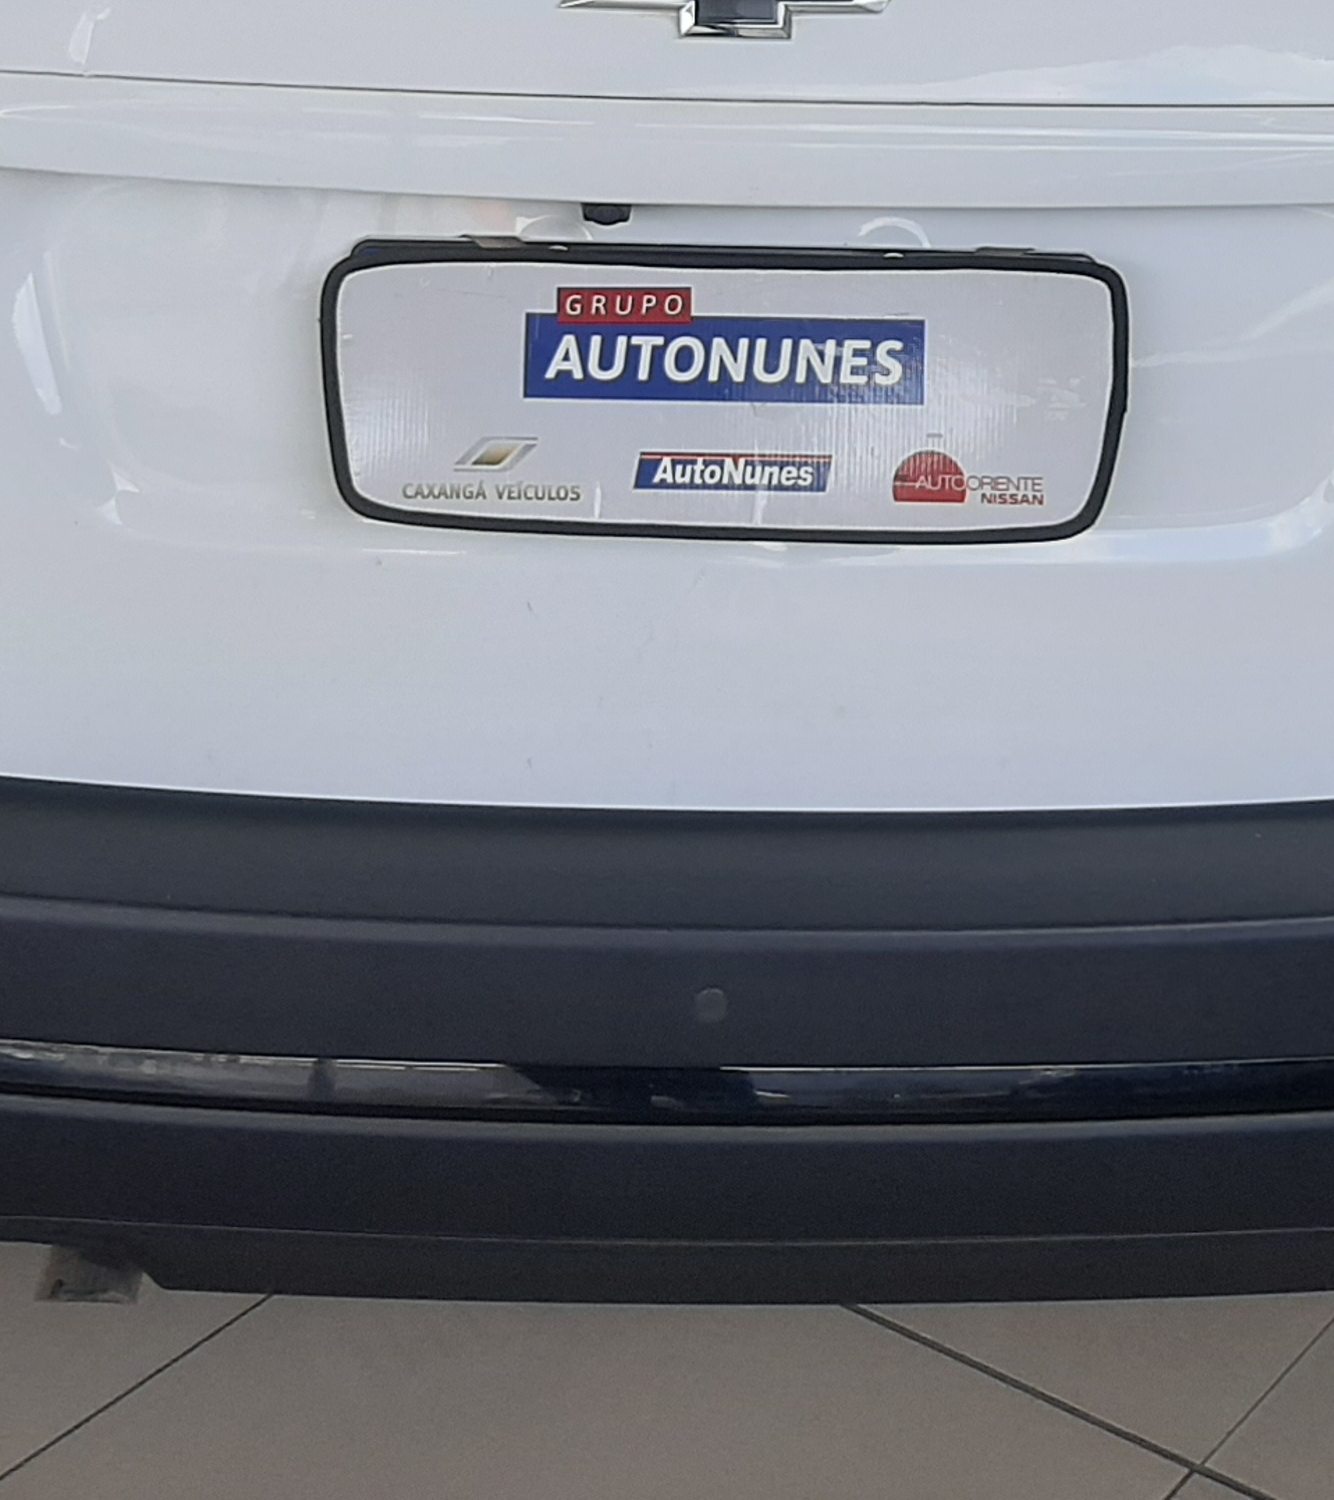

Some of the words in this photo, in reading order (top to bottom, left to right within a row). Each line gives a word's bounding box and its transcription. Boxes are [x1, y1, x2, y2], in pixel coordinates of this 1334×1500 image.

[565, 293, 683, 316] GRUPO
[544, 334, 904, 385] AUTONUNES
[652, 457, 815, 486] AutoNunes
[402, 481, 487, 500] CAXANGÁ
[496, 481, 581, 501] VEÍCULOS
[980, 492, 1044, 505] NISSAN
